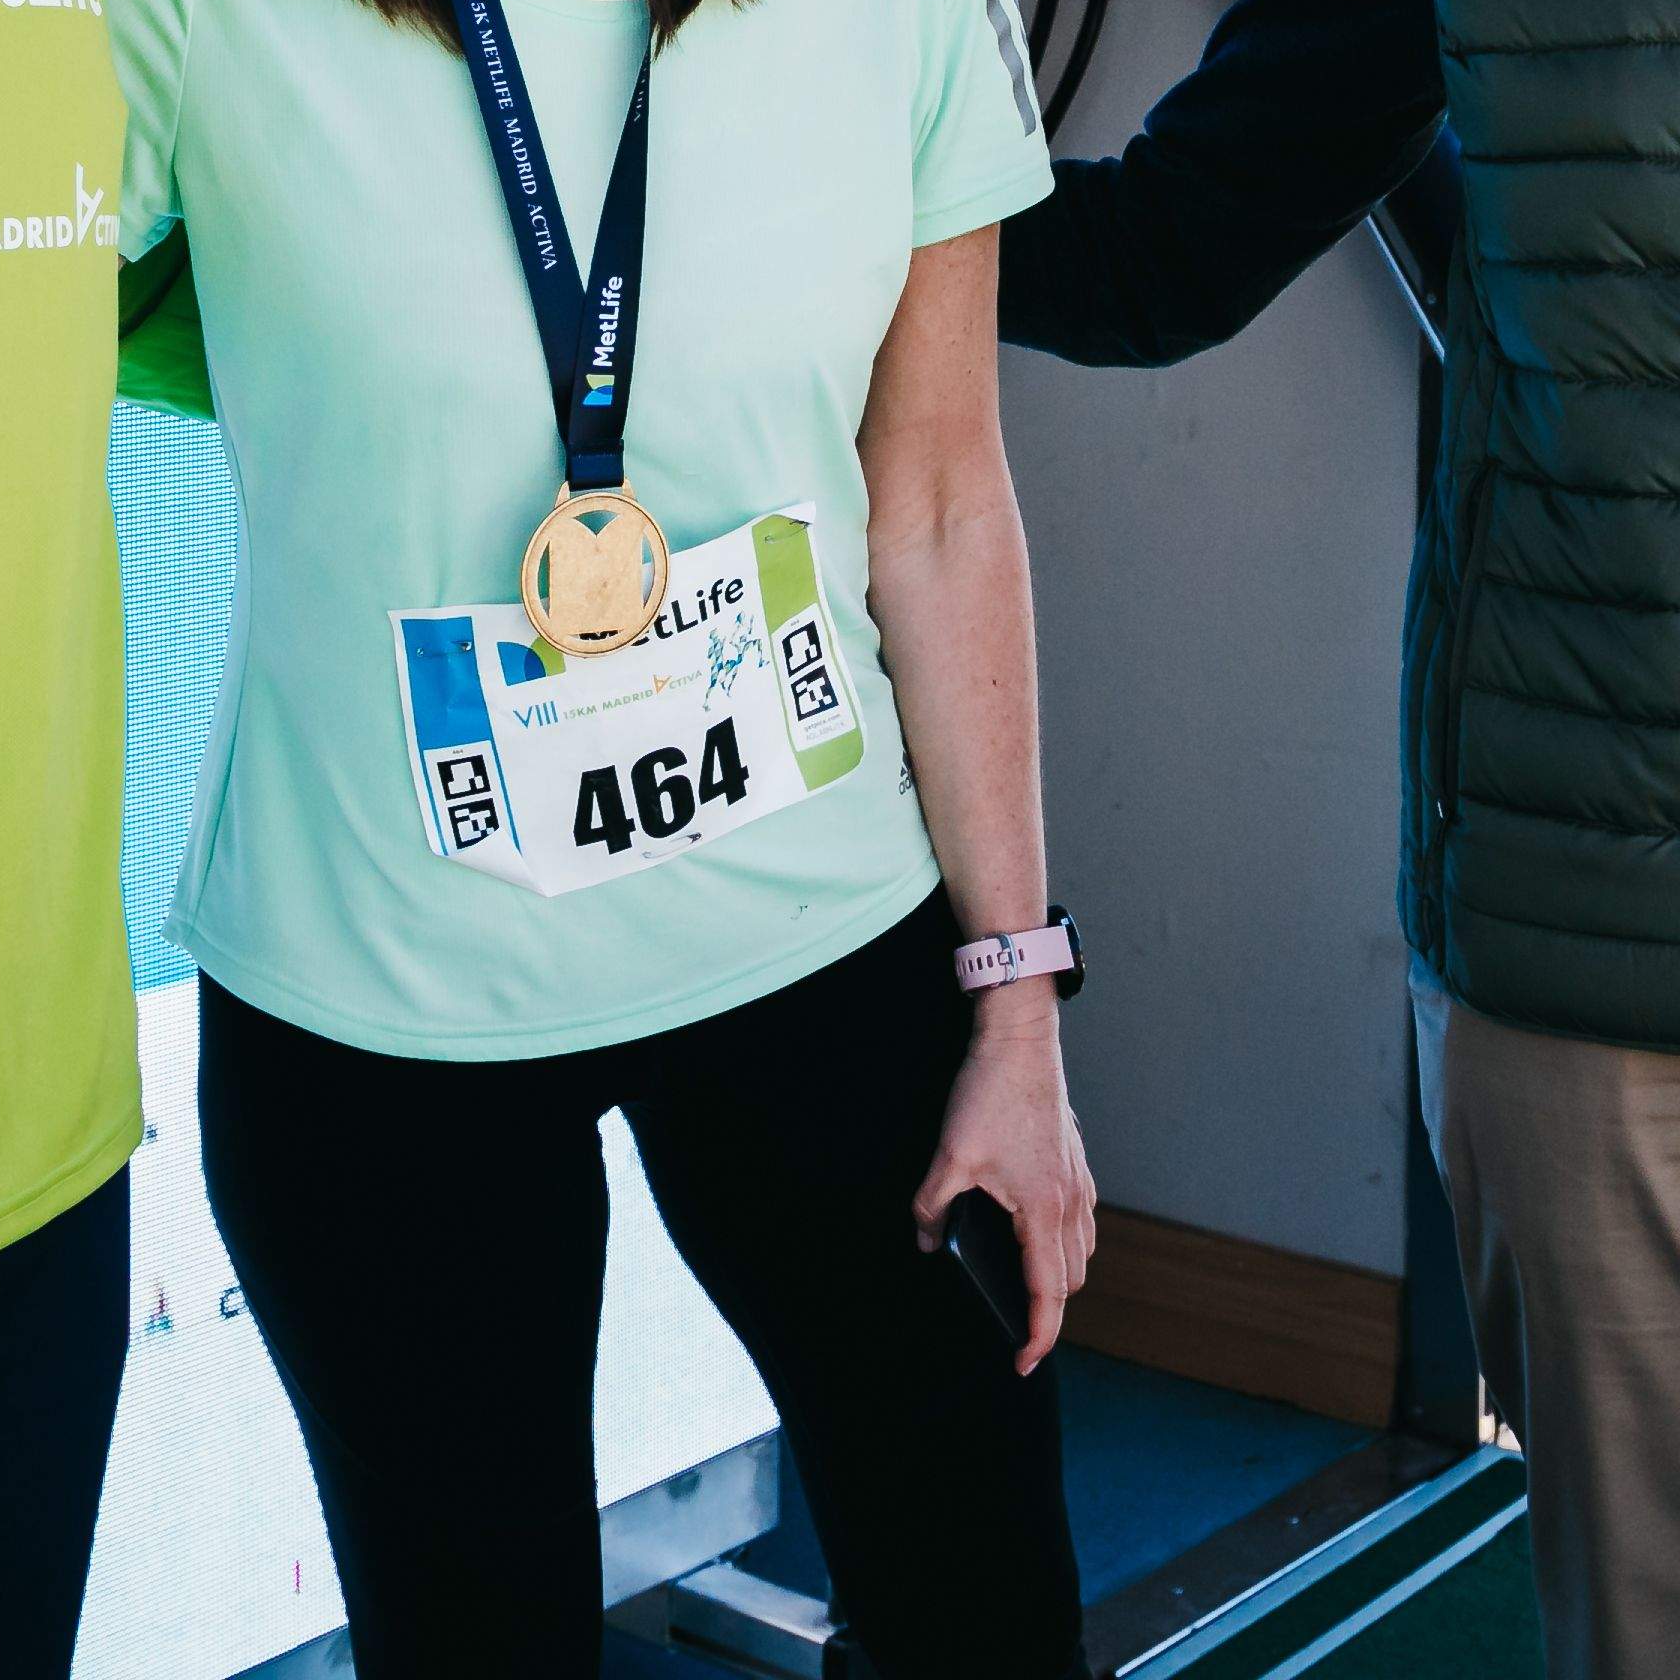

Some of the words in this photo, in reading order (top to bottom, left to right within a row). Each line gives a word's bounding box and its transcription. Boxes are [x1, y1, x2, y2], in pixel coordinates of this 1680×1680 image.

[478, 28, 514, 110] METLIFE
[503, 118, 538, 196] MADRID
[527, 202, 558, 271] ACTIVA
[592, 275, 624, 367] MetLife
[579, 578, 744, 647] tLife
[513, 700, 559, 729] VIII
[562, 704, 598, 721] 15KM
[602, 689, 653, 712] MADRID
[572, 715, 751, 856] 464
